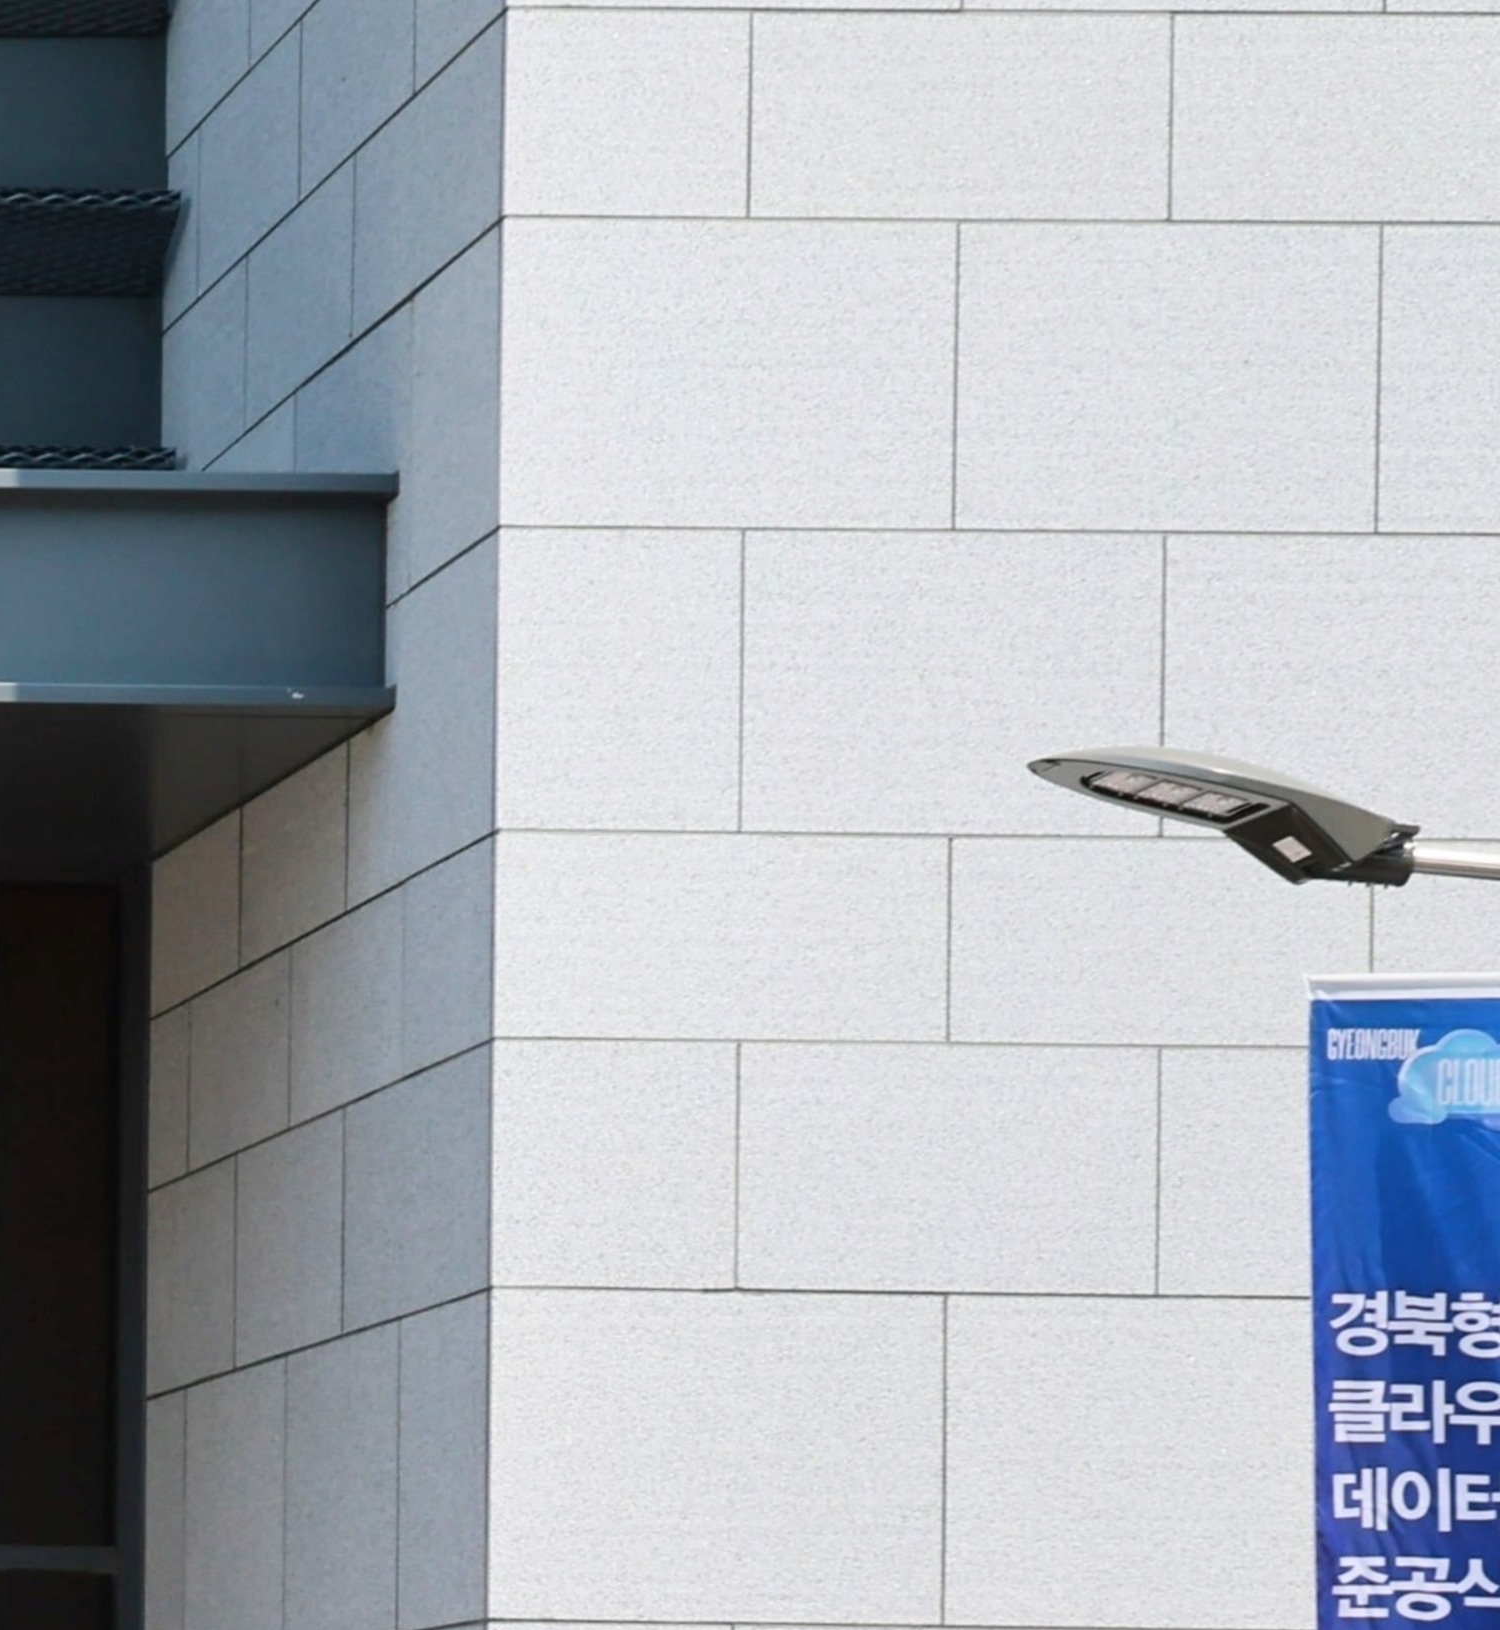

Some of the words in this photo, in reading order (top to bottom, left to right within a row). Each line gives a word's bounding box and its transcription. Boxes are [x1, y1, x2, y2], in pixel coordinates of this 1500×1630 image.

[1327, 1029, 1424, 1064] GYEONGBUK
[1437, 1059, 1500, 1108] CLOU
[1328, 1380, 1500, 1444] 클라우
